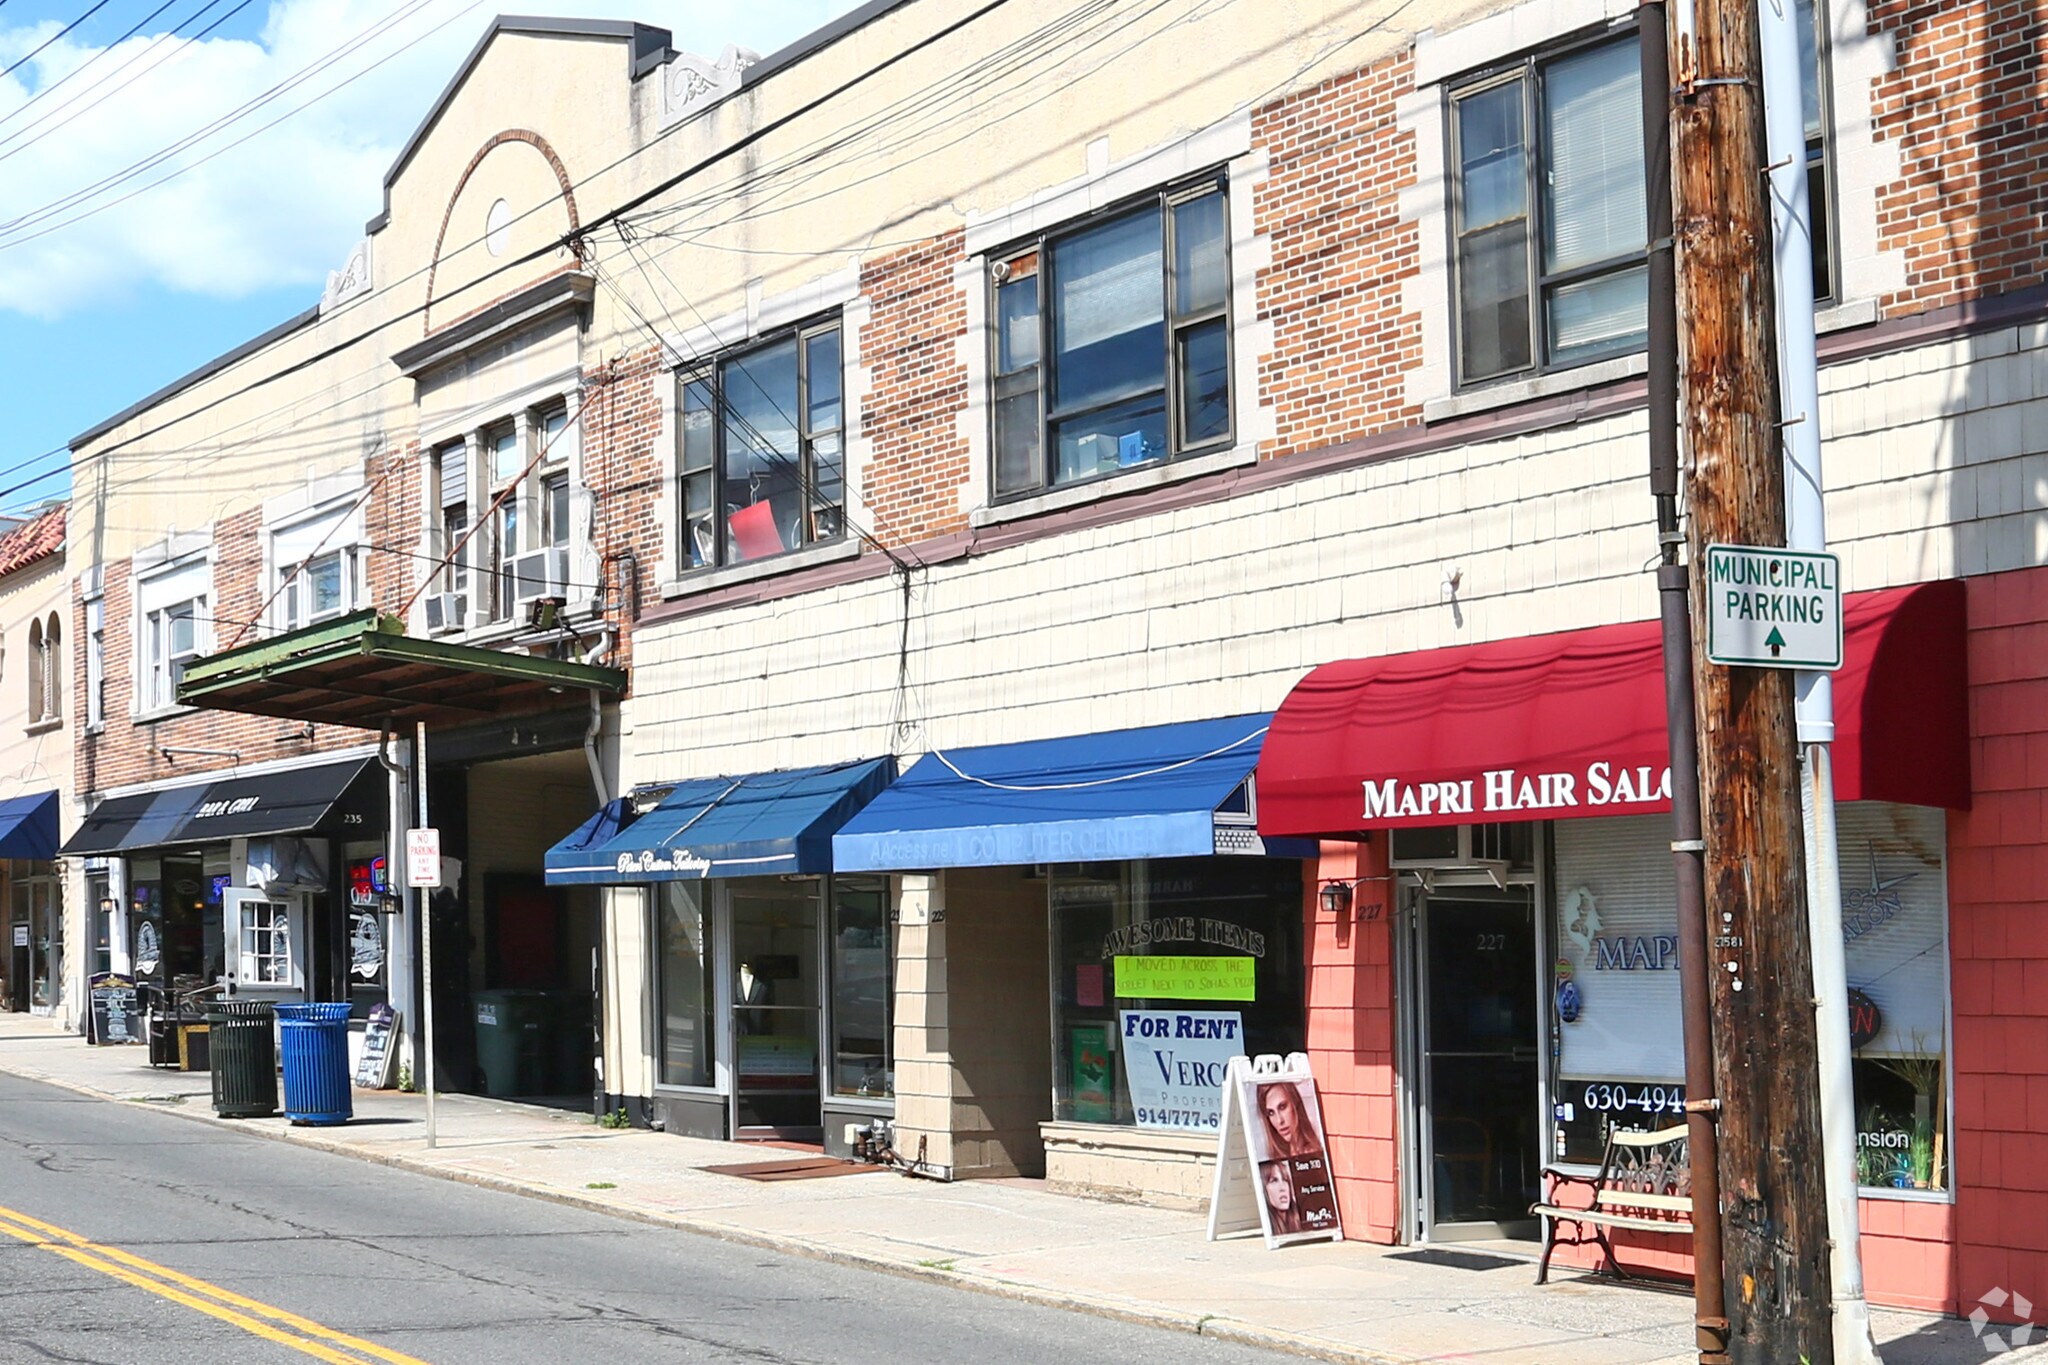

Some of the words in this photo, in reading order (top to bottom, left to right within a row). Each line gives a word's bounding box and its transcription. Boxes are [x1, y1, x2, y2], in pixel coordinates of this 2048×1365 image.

[1714, 555, 1833, 590] MUNICIPAL
[1726, 591, 1824, 624] PARKING
[1482, 769, 1579, 812] HAIR
[343, 814, 363, 824] 235
[417, 833, 429, 844] NO
[1079, 827, 1159, 854] CENTER
[410, 845, 437, 855] PARKING
[418, 857, 430, 865] ANY
[1358, 903, 1382, 920] 227
[1843, 891, 1904, 945] ALON
[1101, 917, 1195, 959] AWESOME
[1200, 917, 1265, 958] ITEMS
[1476, 934, 1505, 950] 227
[1136, 957, 1176, 972] MOVED
[1181, 958, 1218, 972] ACROSS
[1225, 959, 1245, 972] THE
[1153, 978, 1176, 991] NEXT
[1183, 979, 1195, 990] TO
[1125, 1015, 1170, 1038] FOR
[1175, 1015, 1238, 1040] RENT
[1154, 1050, 1229, 1087] VERC
[1584, 1084, 1687, 1113] 630-494
[1138, 1107, 1222, 1128] 914/777-6
[1855, 1127, 1909, 1148] nsion
